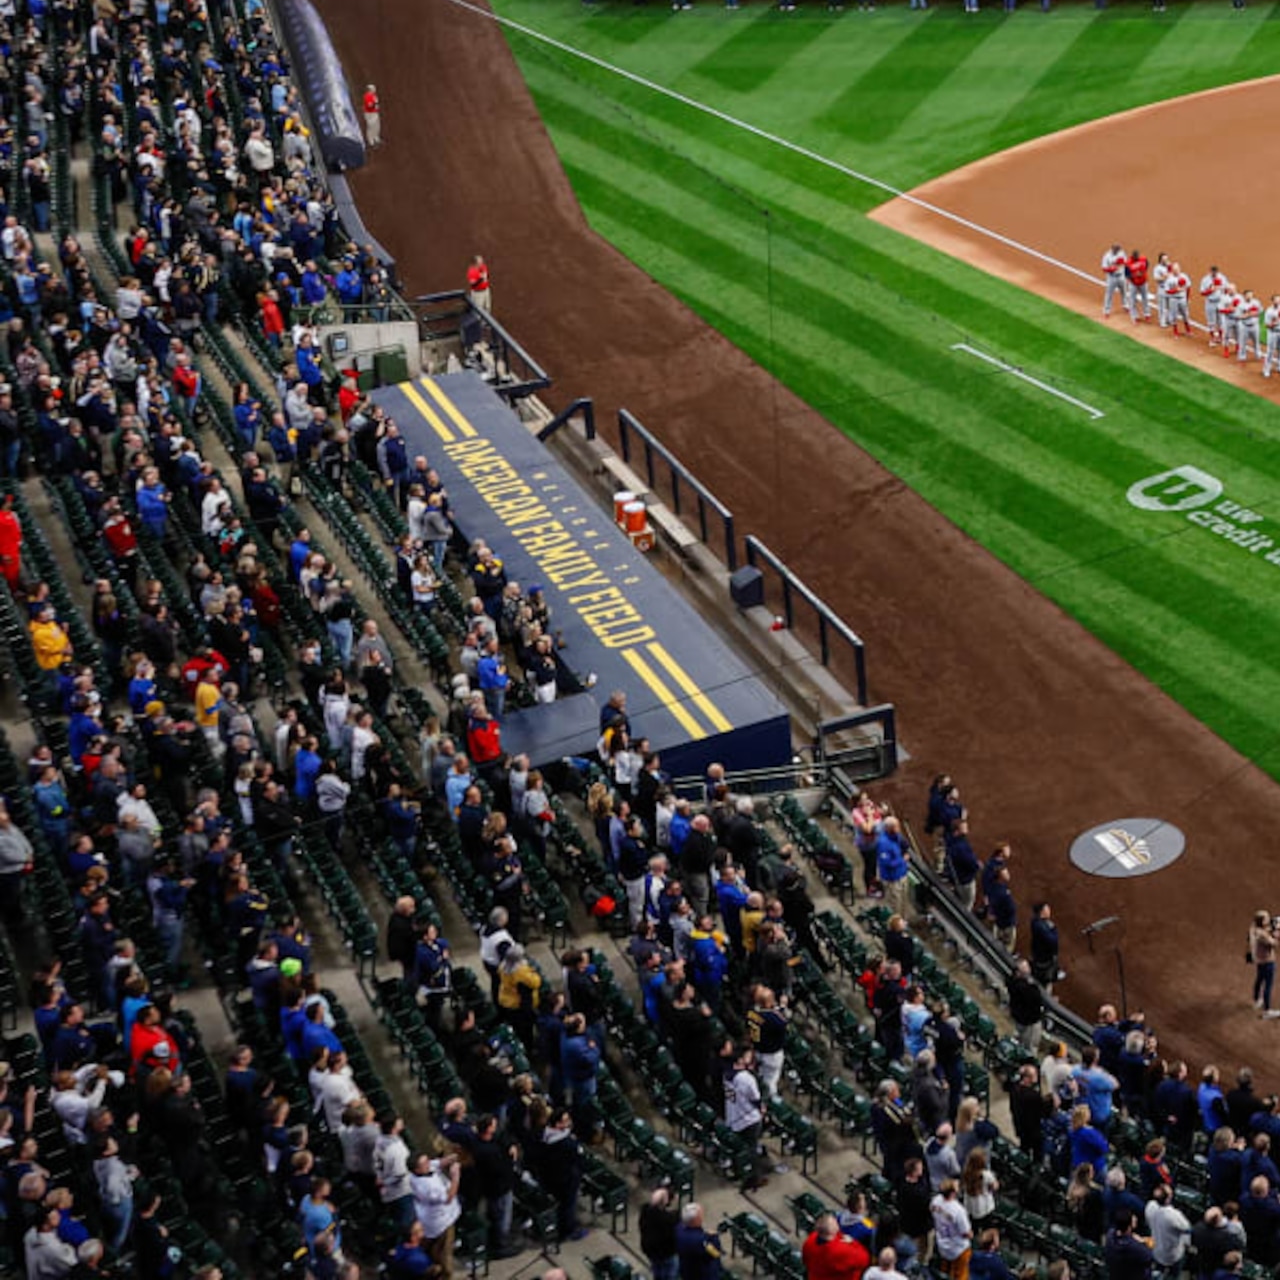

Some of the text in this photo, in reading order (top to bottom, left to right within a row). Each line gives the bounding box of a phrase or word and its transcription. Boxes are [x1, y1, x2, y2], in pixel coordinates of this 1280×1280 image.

[1186, 509, 1275, 553] credit
[1213, 499, 1265, 524] uw
[442, 438, 554, 527] AMERICAN
[511, 520, 612, 591] FAMILY
[567, 585, 657, 649] FIELD
